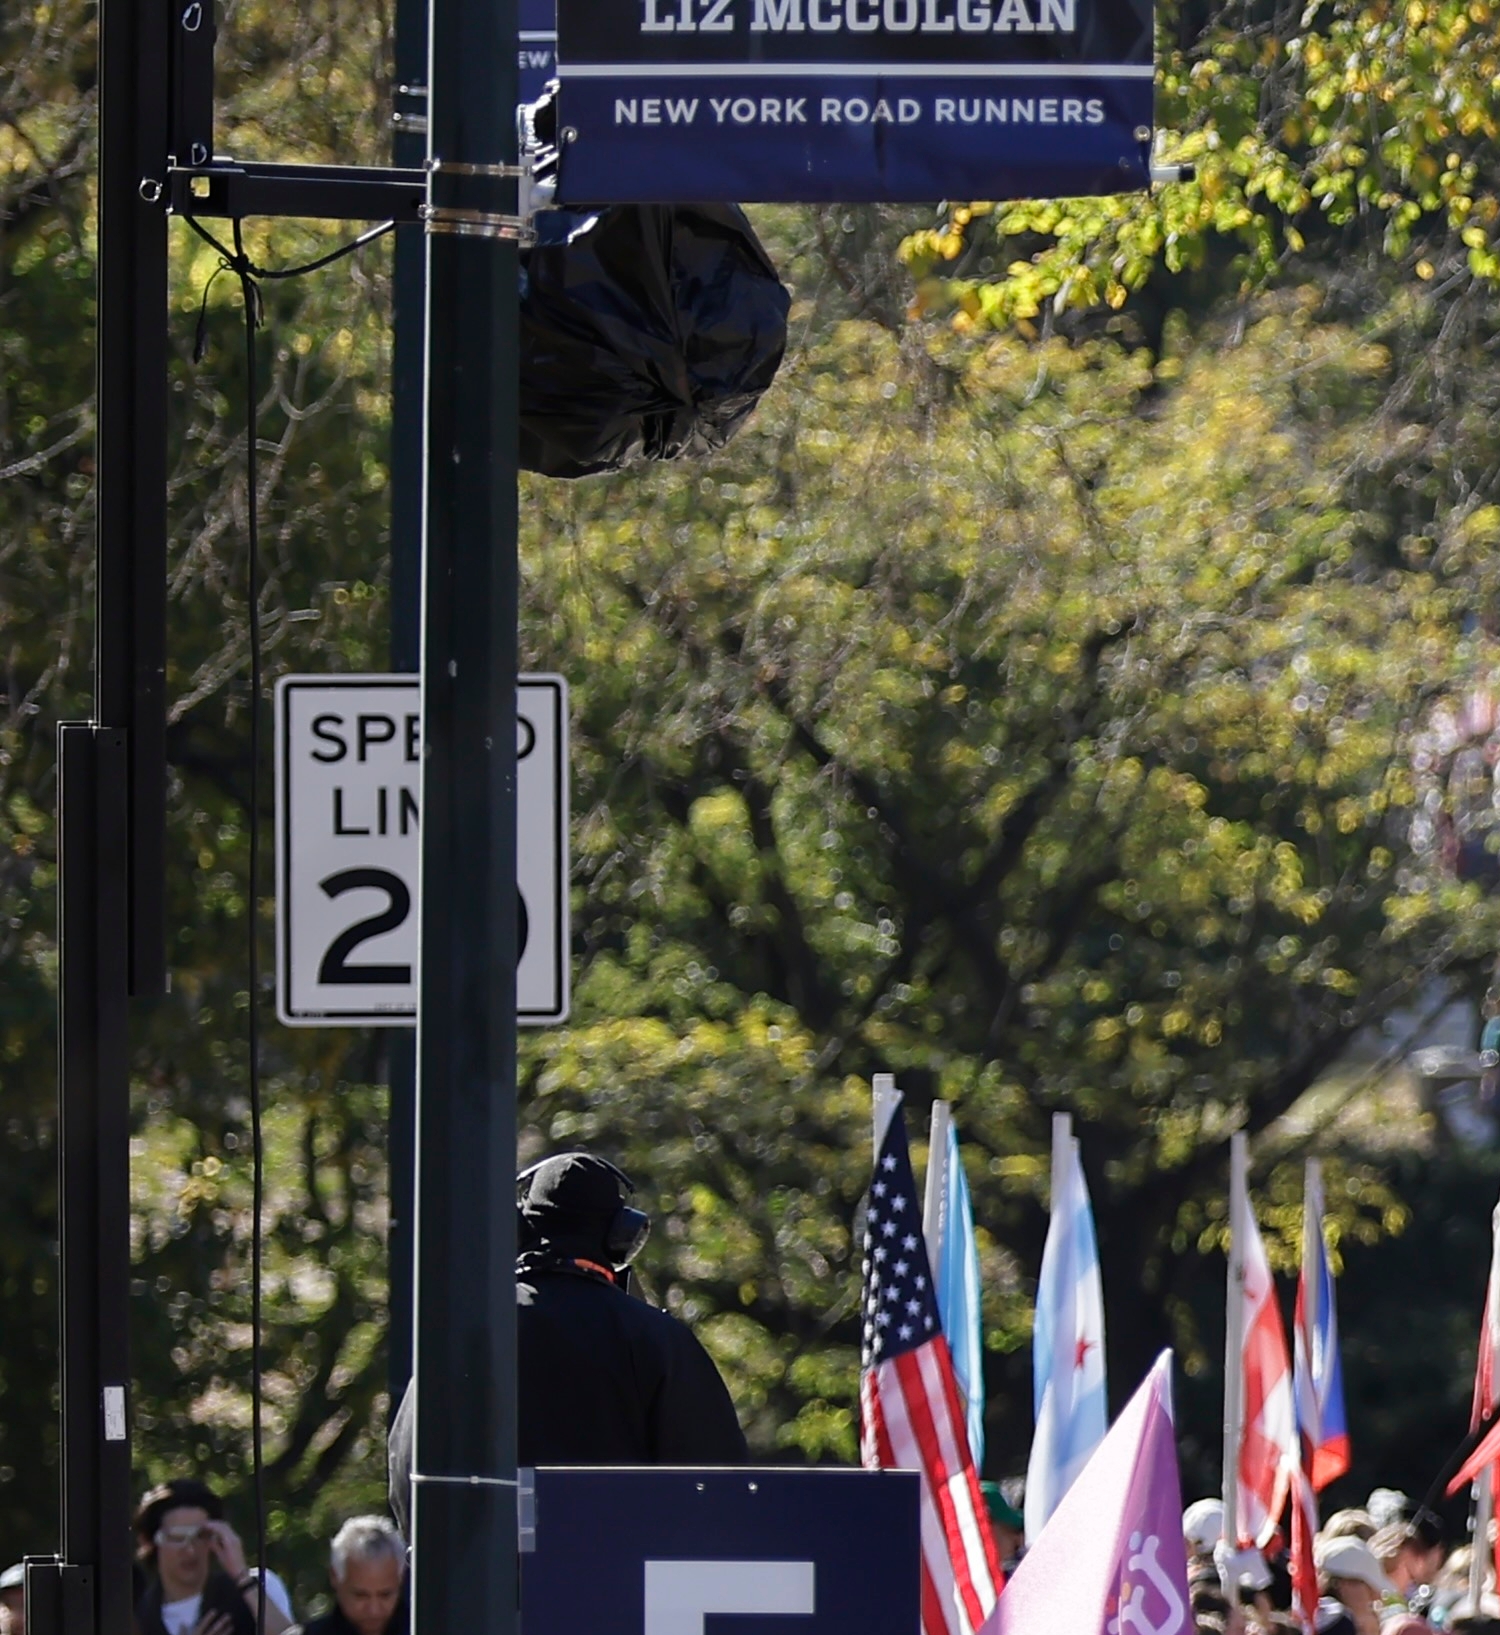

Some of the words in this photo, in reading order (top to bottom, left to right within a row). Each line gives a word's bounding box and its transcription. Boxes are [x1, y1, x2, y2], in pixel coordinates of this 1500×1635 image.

[640, 0, 733, 31] LIZ
[750, 0, 1075, 32] MCCOLGAN
[518, 51, 551, 69] EW
[614, 99, 700, 123] NEW
[709, 98, 808, 123] YORK
[820, 98, 921, 123] ROAD
[934, 98, 1105, 123] RUNNERS
